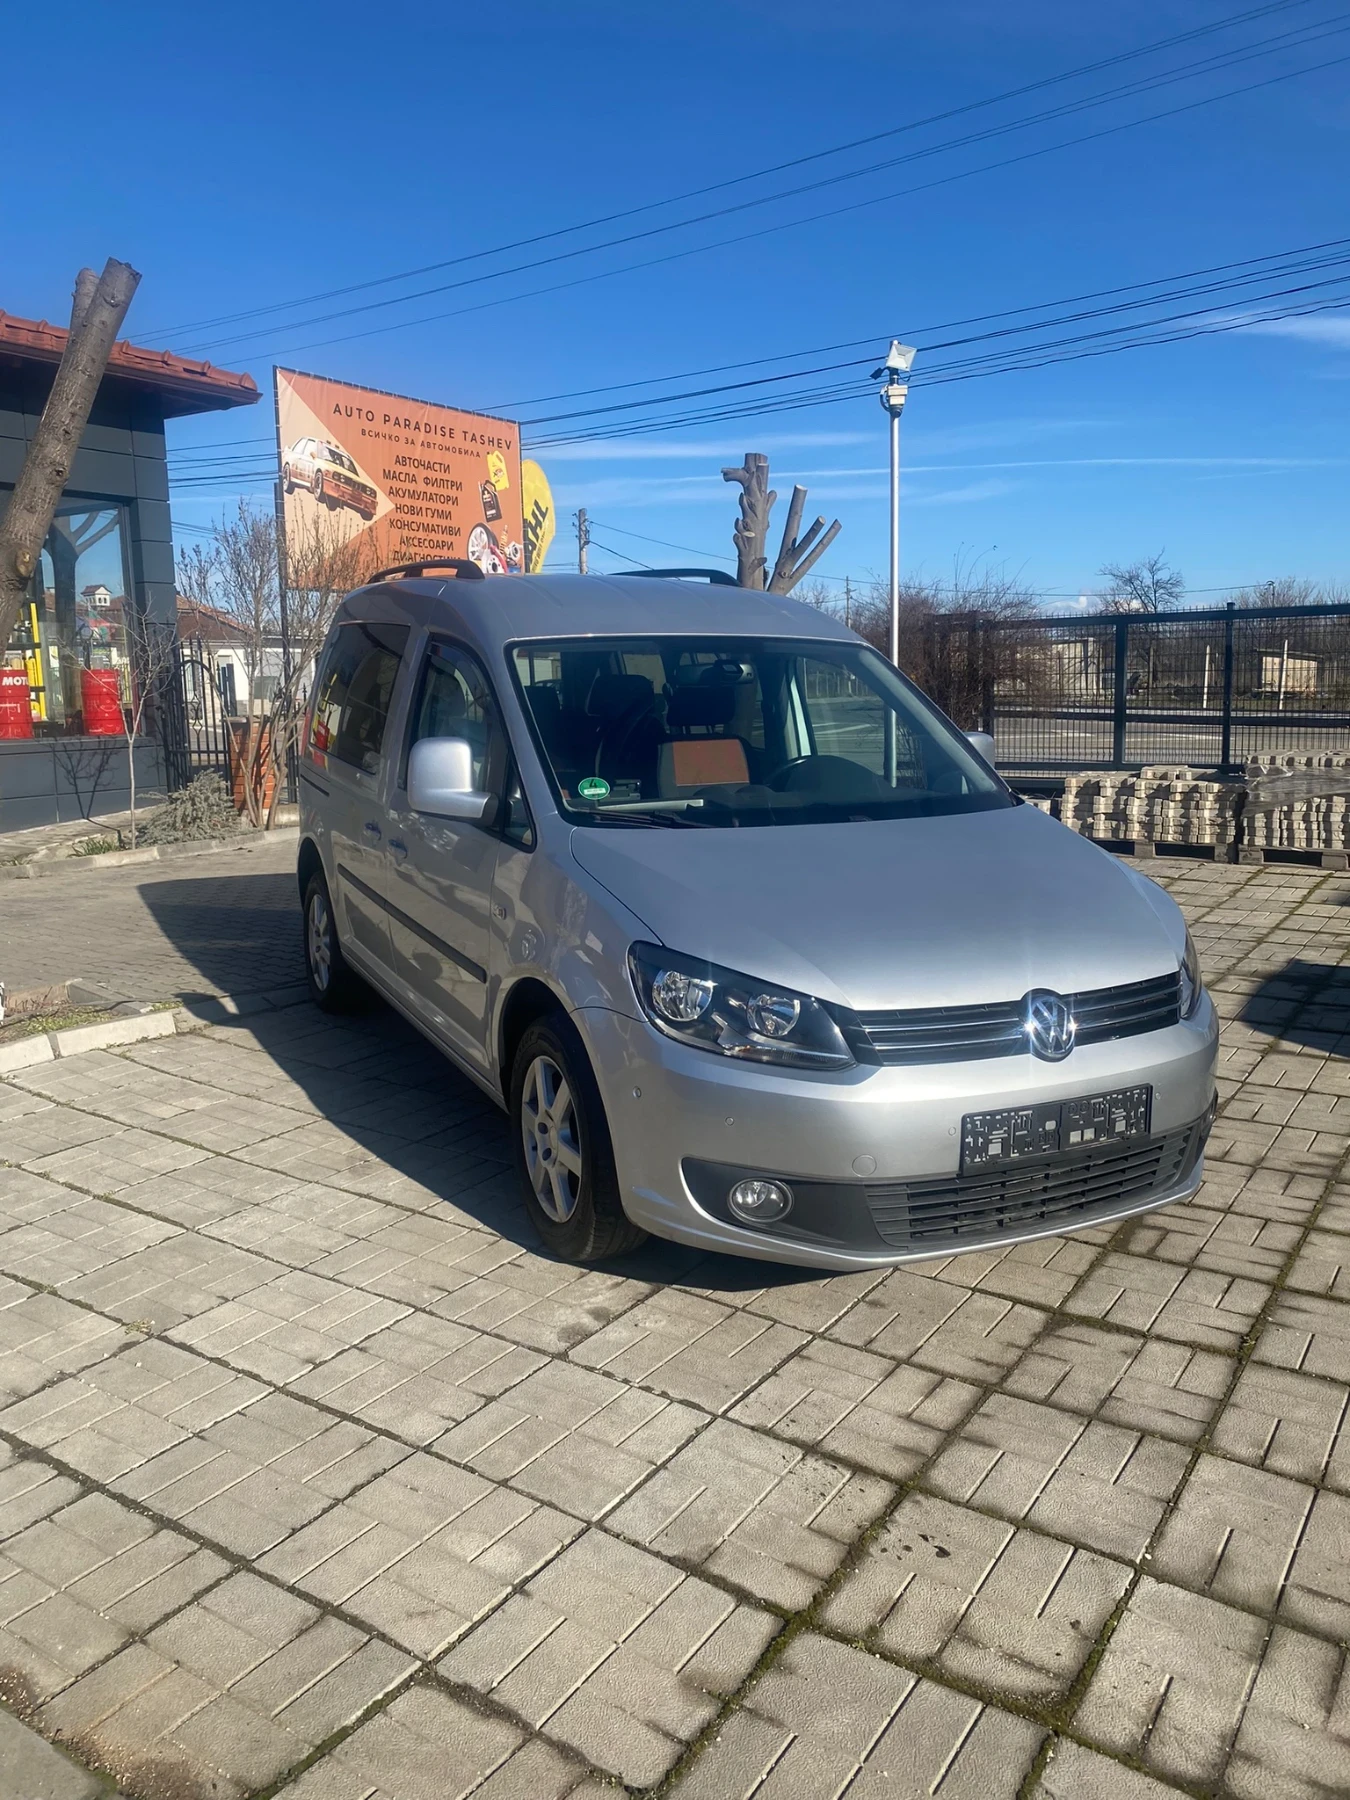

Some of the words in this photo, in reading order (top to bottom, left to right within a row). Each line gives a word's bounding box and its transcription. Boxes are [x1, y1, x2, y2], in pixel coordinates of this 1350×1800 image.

[333, 403, 375, 422] AUTO
[383, 413, 455, 439] PARADISE
[462, 430, 511, 450] TASHEV
[361, 428, 400, 443] ВСИЧКО
[404, 437, 415, 446] ЗА
[420, 440, 481, 458] АВТОМОБИЛА
[394, 454, 451, 474] АВТОЧАСТИ
[382, 468, 418, 485] МАСЛА
[423, 476, 463, 492] ФИЛТРИ
[388, 486, 459, 506] АКУМУЛАТОРИ
[395, 503, 423, 517] НОВИ
[425, 507, 452, 521] ГУМИ
[389, 517, 461, 537] КОНСУМАТИВИ
[399, 535, 454, 551] АКСЕСОАРИ
[393, 550, 461, 563] ДИАГНОС
